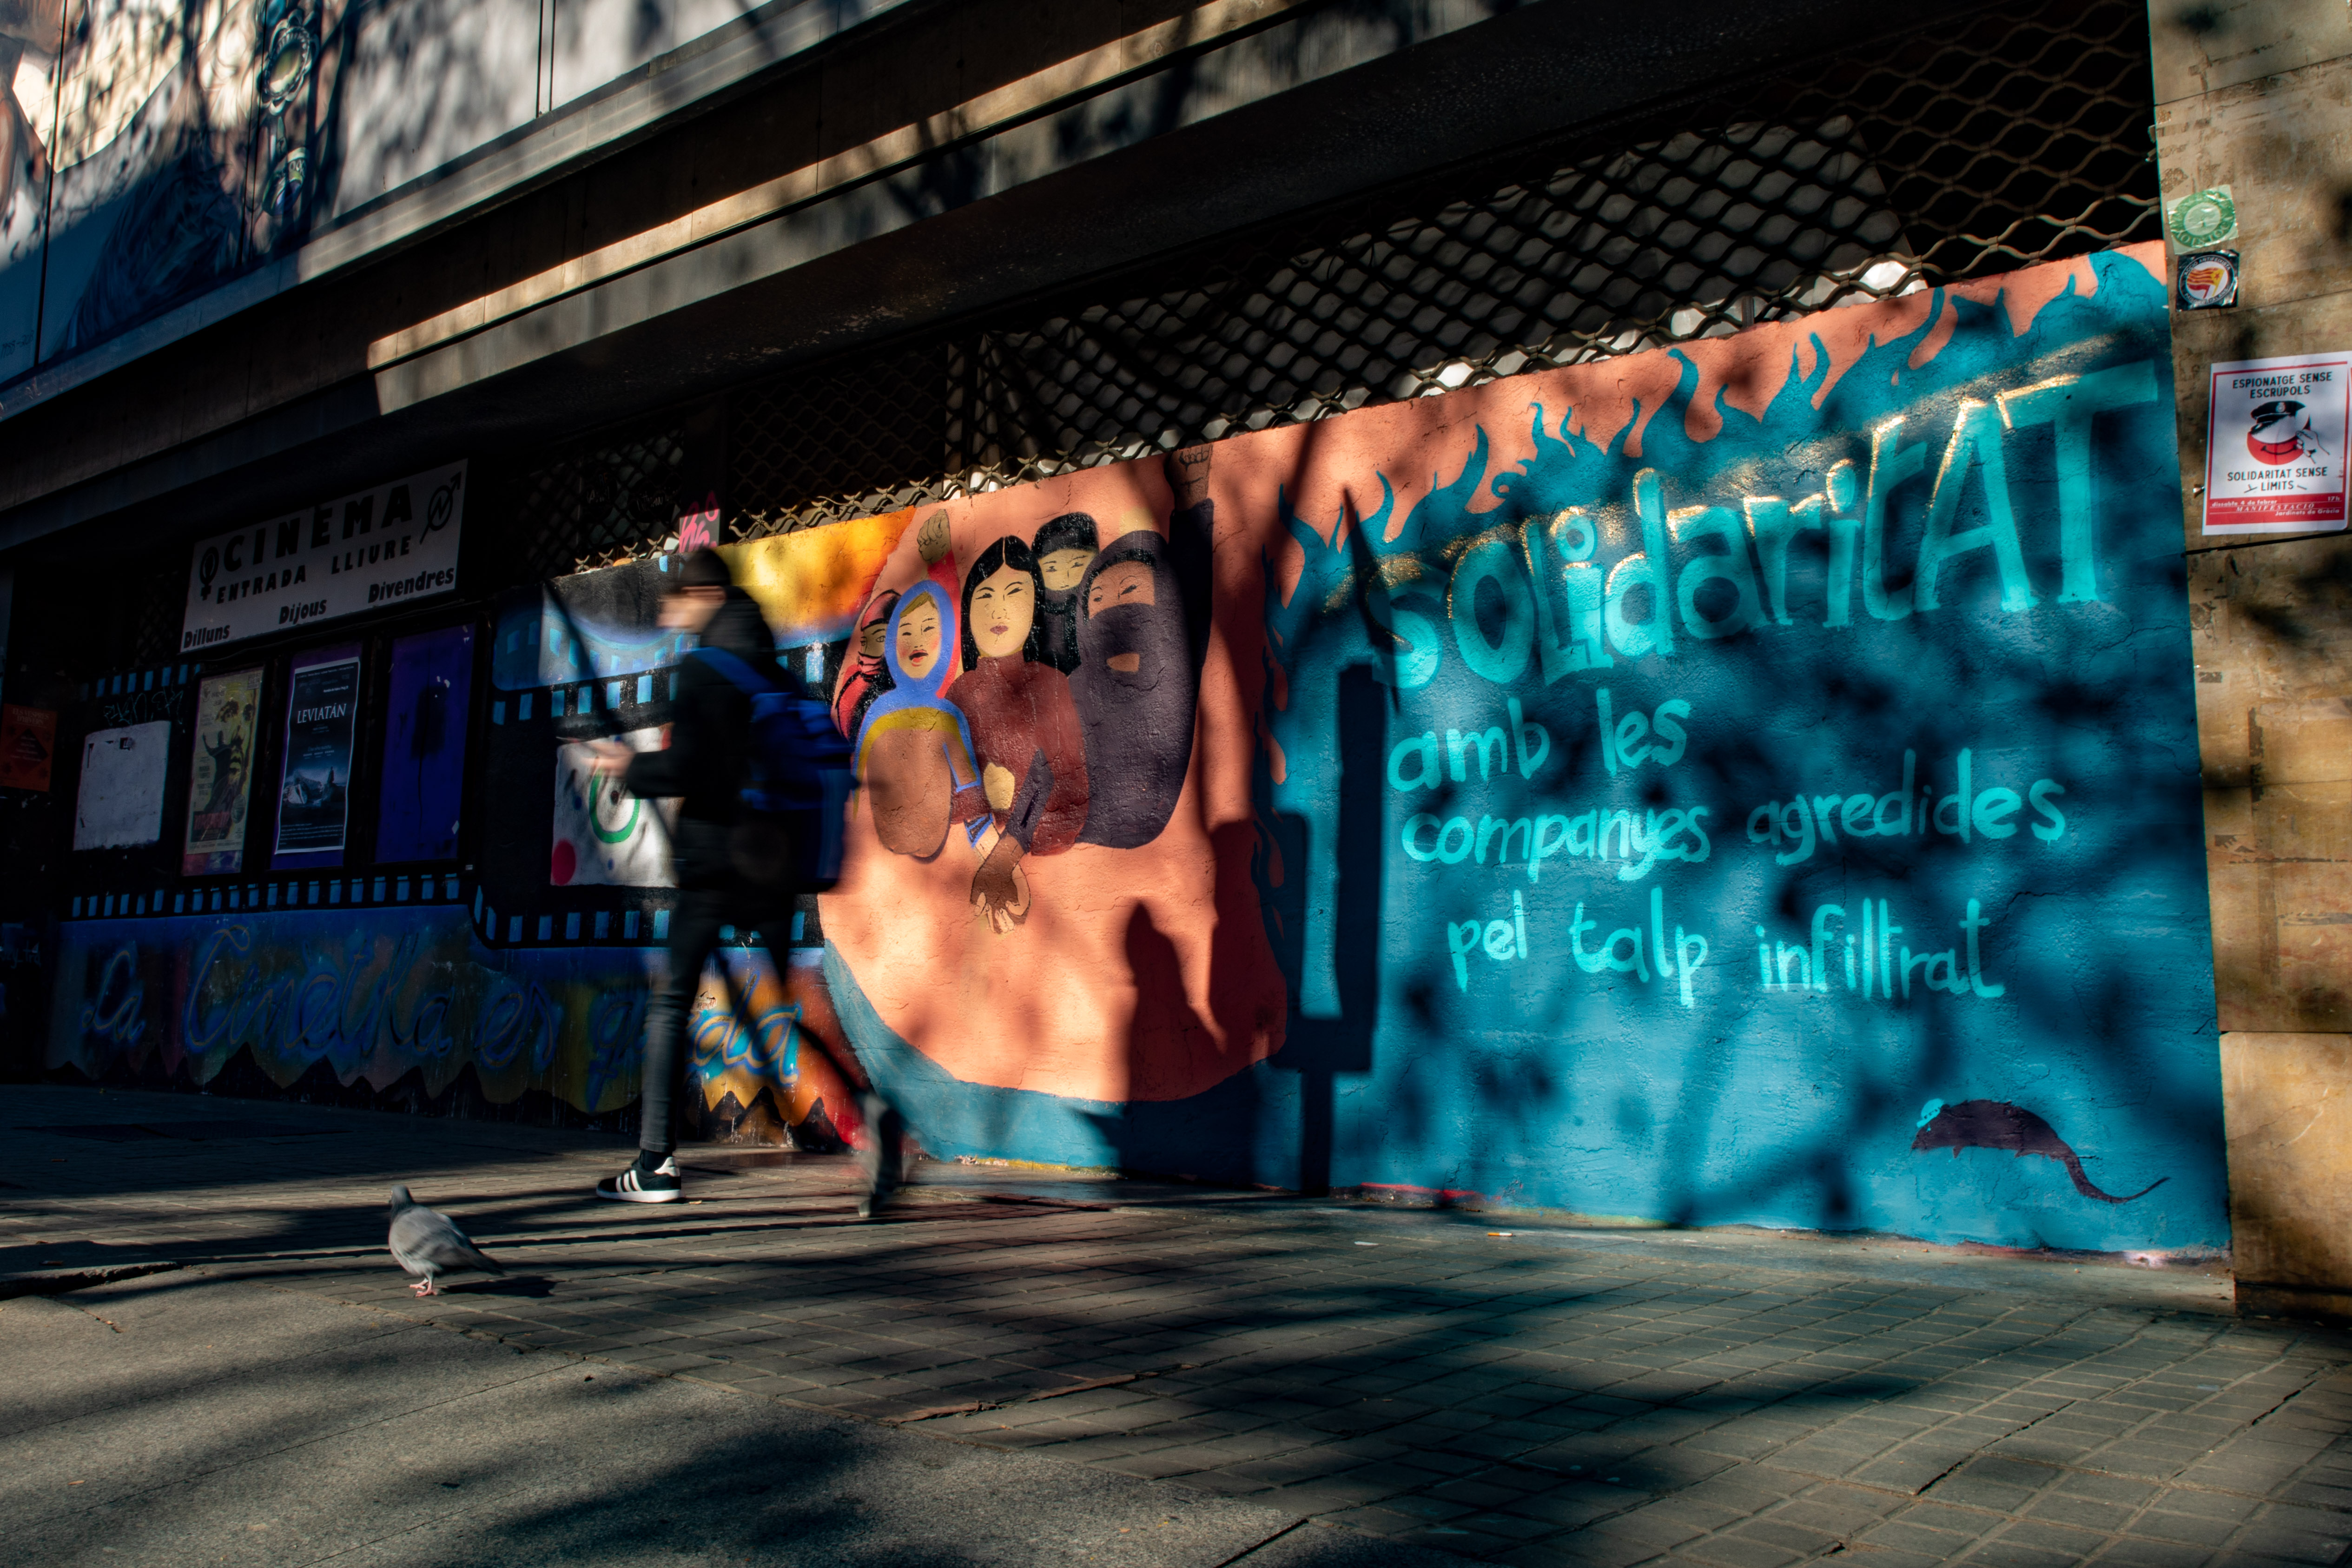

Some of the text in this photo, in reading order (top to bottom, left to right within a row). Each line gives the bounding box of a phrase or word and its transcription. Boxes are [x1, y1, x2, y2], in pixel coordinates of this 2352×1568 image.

[2233, 371, 2332, 389] ESPIONATGE SENSE
[2250, 384, 2310, 398] ESCRÚPOLS
[2227, 469, 2292, 481] SOLIDARITAT
[2296, 466, 2328, 478] SENSE
[2235, 503, 2315, 512] MANIFESTACIÓ
[2261, 479, 2294, 491] LÍMITS
[224, 483, 413, 572] CINEMA
[217, 535, 411, 604] ENTRADA LLIURE
[184, 567, 455, 648] Dilluns Dijous Divendres
[297, 702, 347, 724] LEVIATÁN
[1387, 688, 1691, 792] amb les
[1401, 747, 2068, 883] companyes agredides
[1447, 886, 2005, 1009] pel talp infiltrat
[82, 950, 148, 1041] La
